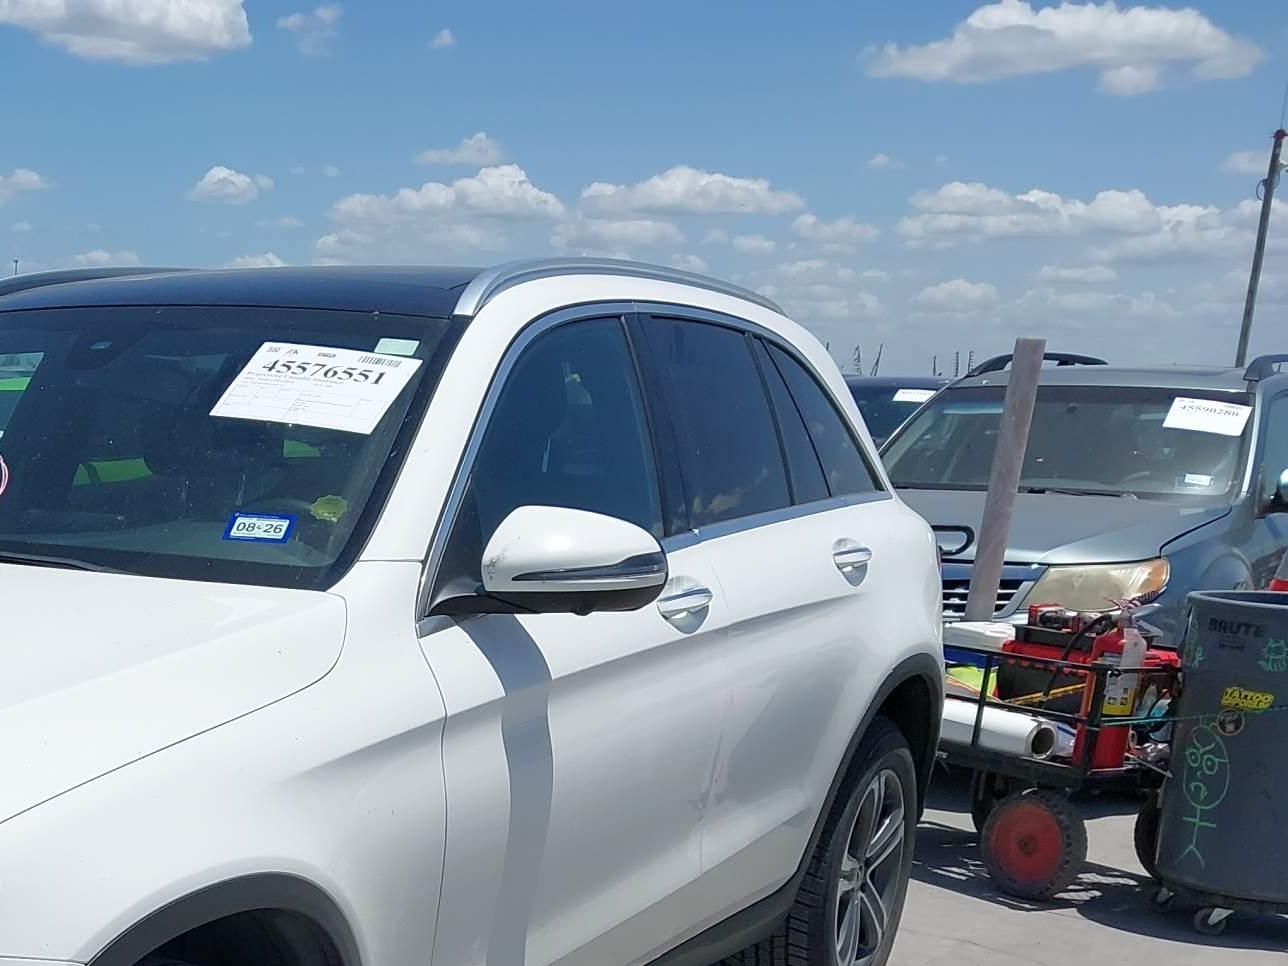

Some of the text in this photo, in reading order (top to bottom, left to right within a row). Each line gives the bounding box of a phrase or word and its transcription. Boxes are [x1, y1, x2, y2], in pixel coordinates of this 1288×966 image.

[262, 359, 386, 385] 45576551
[236, 521, 284, 535] 08 26
[1208, 617, 1265, 638] BRUTE
